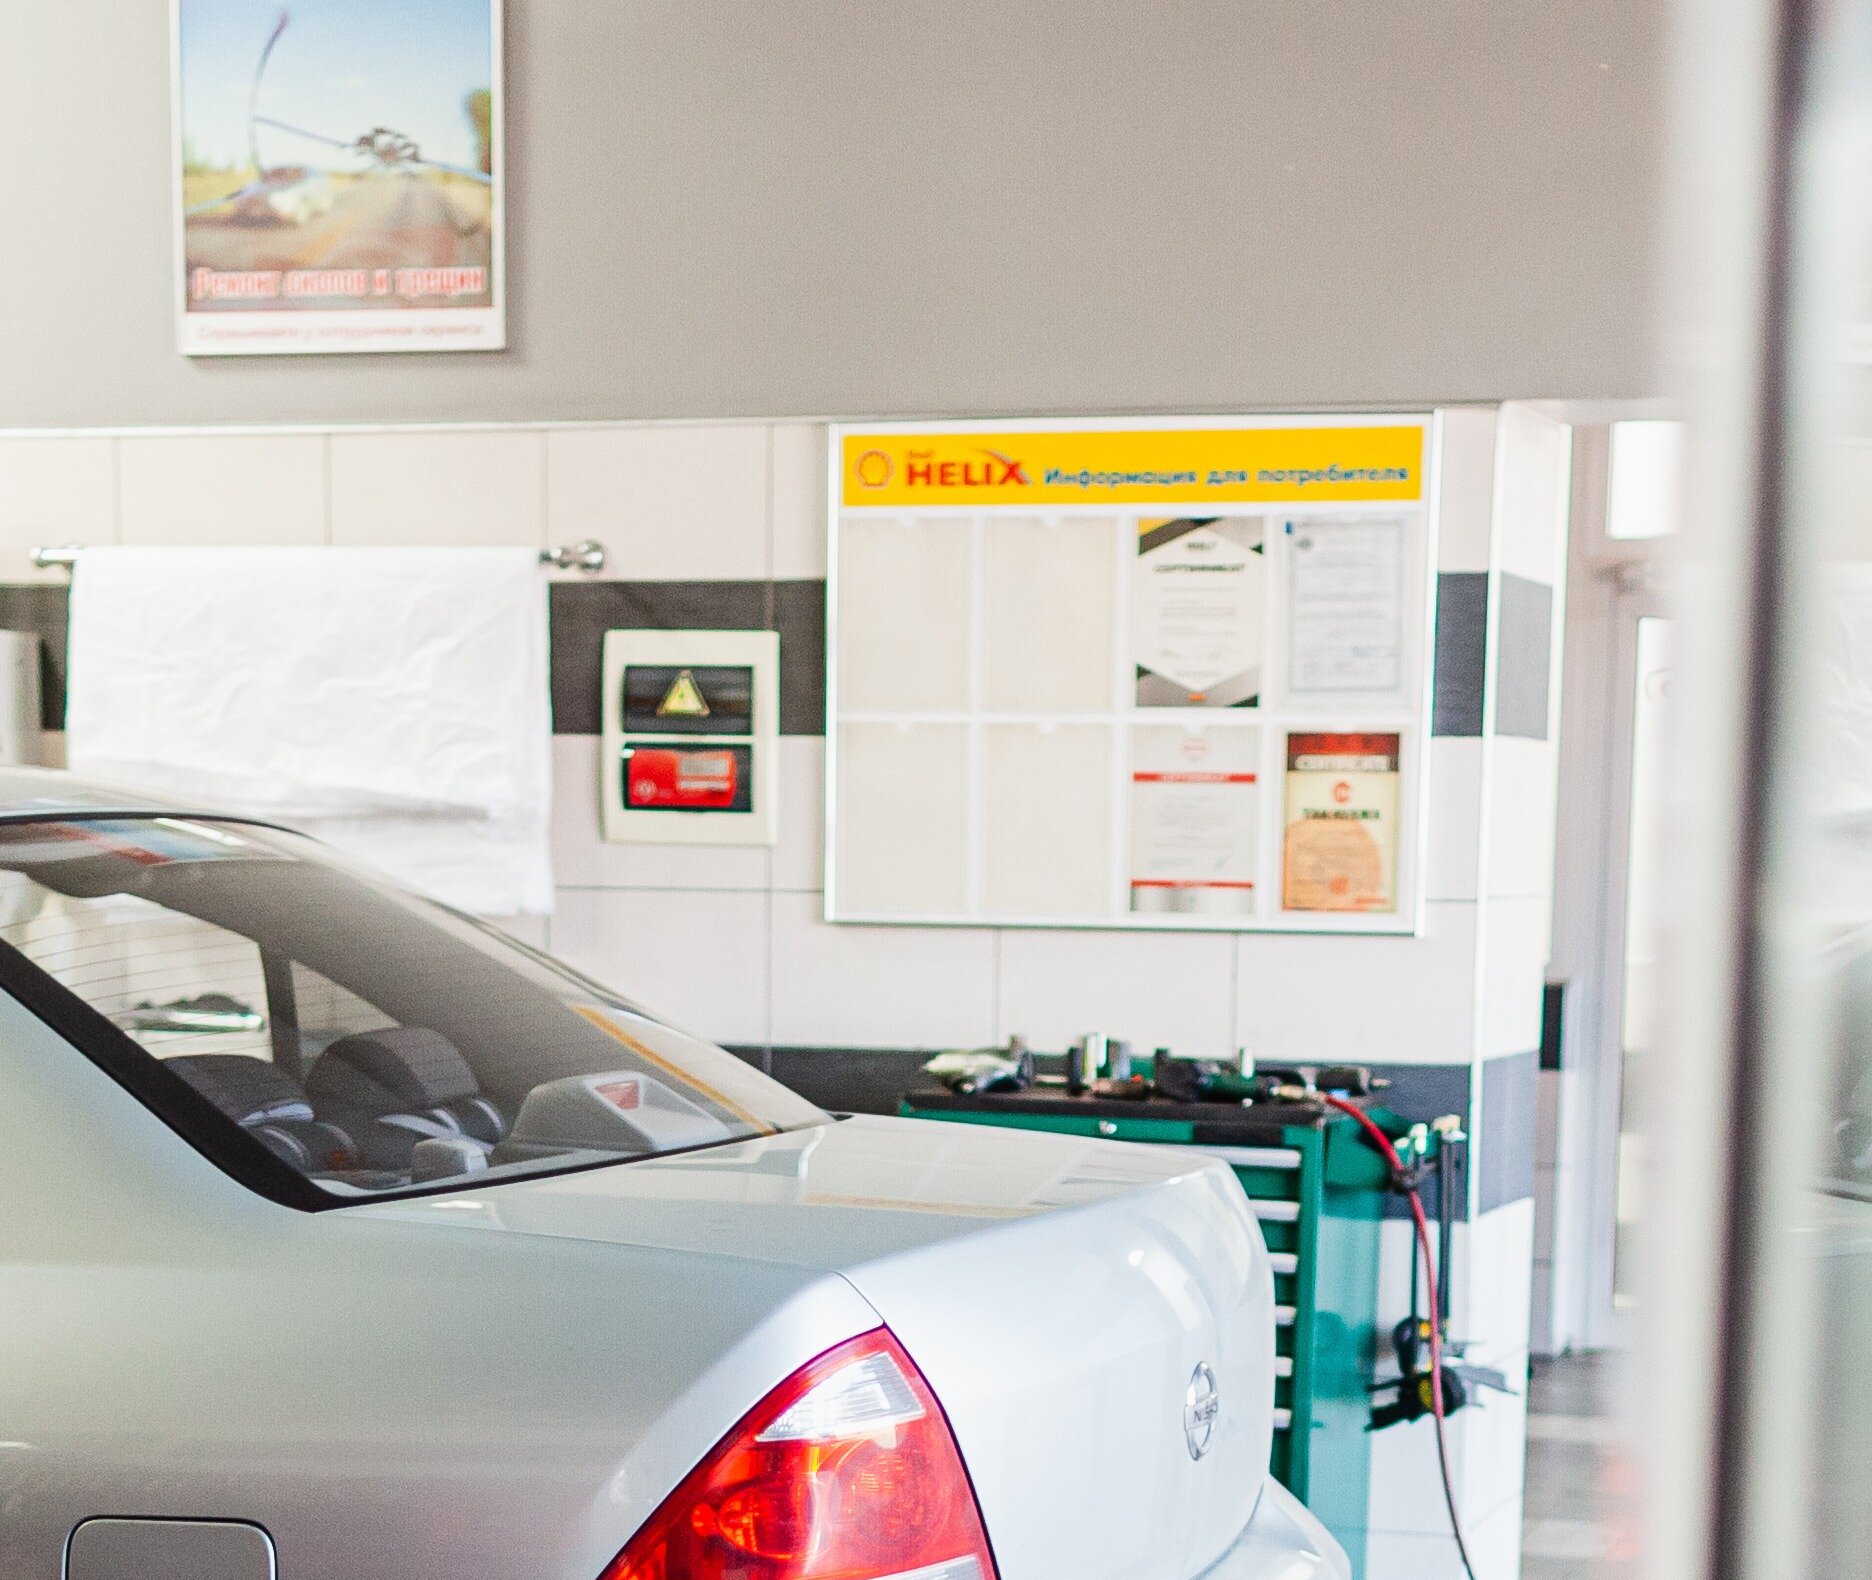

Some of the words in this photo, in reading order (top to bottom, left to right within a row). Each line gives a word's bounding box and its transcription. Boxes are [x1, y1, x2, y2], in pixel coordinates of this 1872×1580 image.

[192, 267, 281, 299] Ремонт
[371, 268, 390, 297] и
[906, 460, 1031, 487] HELIX
[1043, 467, 1198, 489] Информация
[1206, 468, 1248, 486] для
[1257, 463, 1409, 487] потребителя
